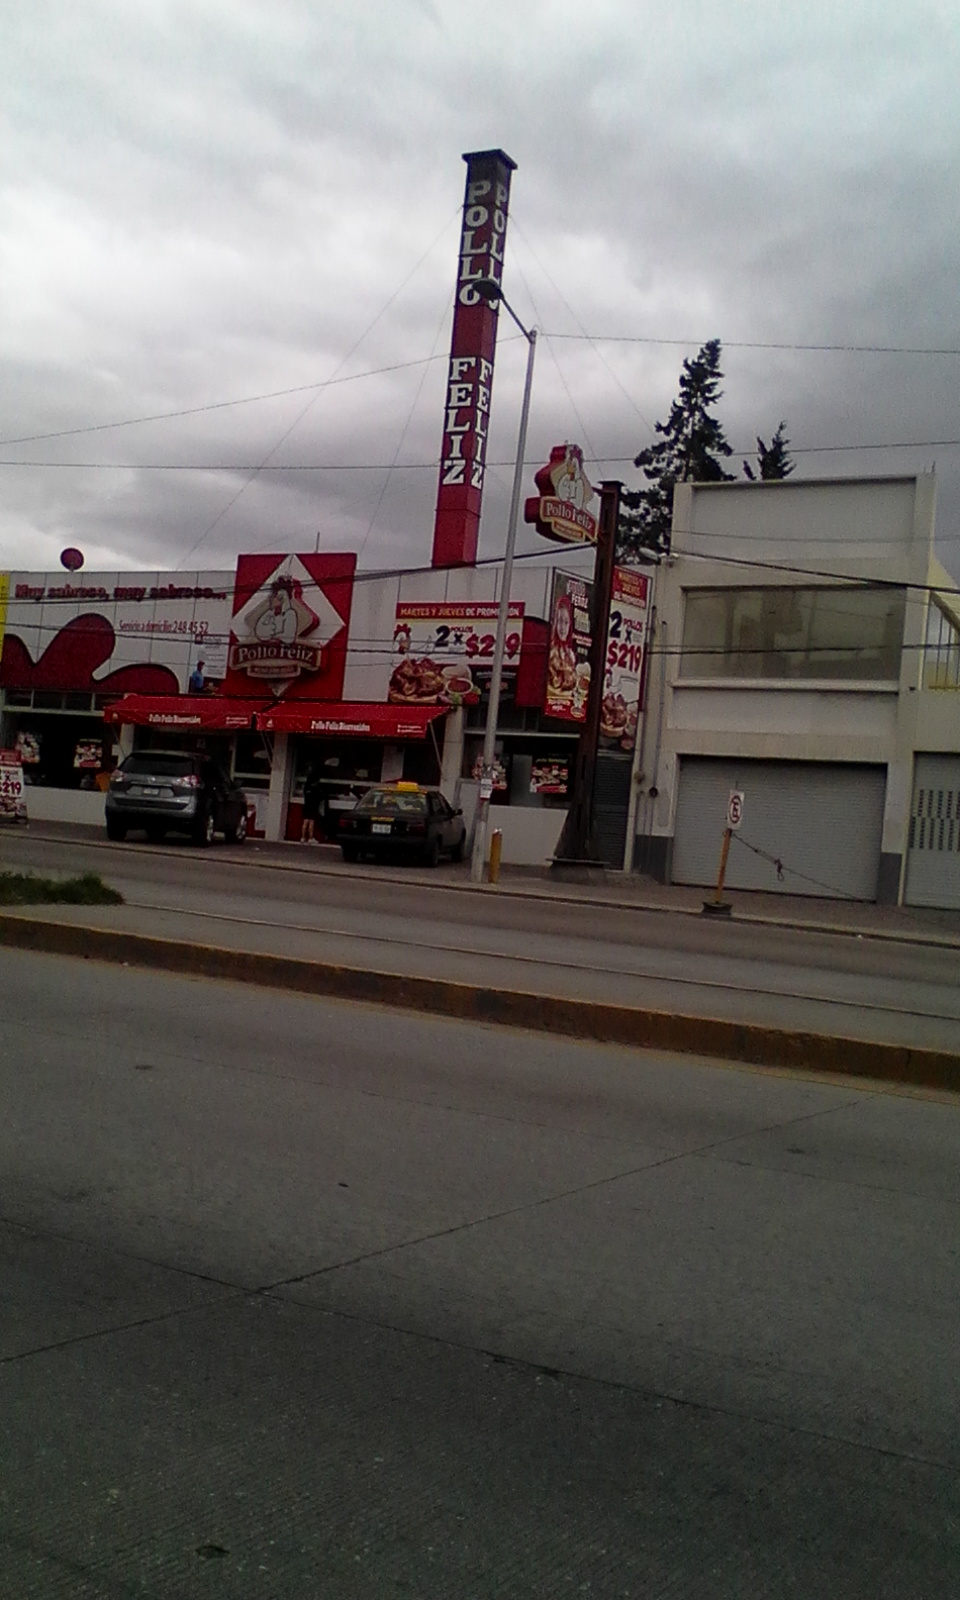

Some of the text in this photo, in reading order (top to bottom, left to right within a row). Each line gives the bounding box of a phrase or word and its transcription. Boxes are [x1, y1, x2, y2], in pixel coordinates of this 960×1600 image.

[459, 180, 491, 306] POLLO
[442, 357, 476, 485] FELIZ
[471, 358, 492, 489] FELIZ
[546, 502, 572, 519] Pollo
[15, 584, 45, 601] Muy
[400, 607, 429, 616] MARTES
[431, 607, 436, 616] Y
[438, 607, 465, 616] JUEVES
[466, 607, 475, 616] DE
[171, 621, 187, 634] 248
[199, 621, 209, 634] 52
[435, 625, 450, 647] 2
[609, 611, 621, 638] 2
[239, 647, 276, 662] Pollo
[466, 633, 520, 660] $29
[607, 640, 641, 672] $219
